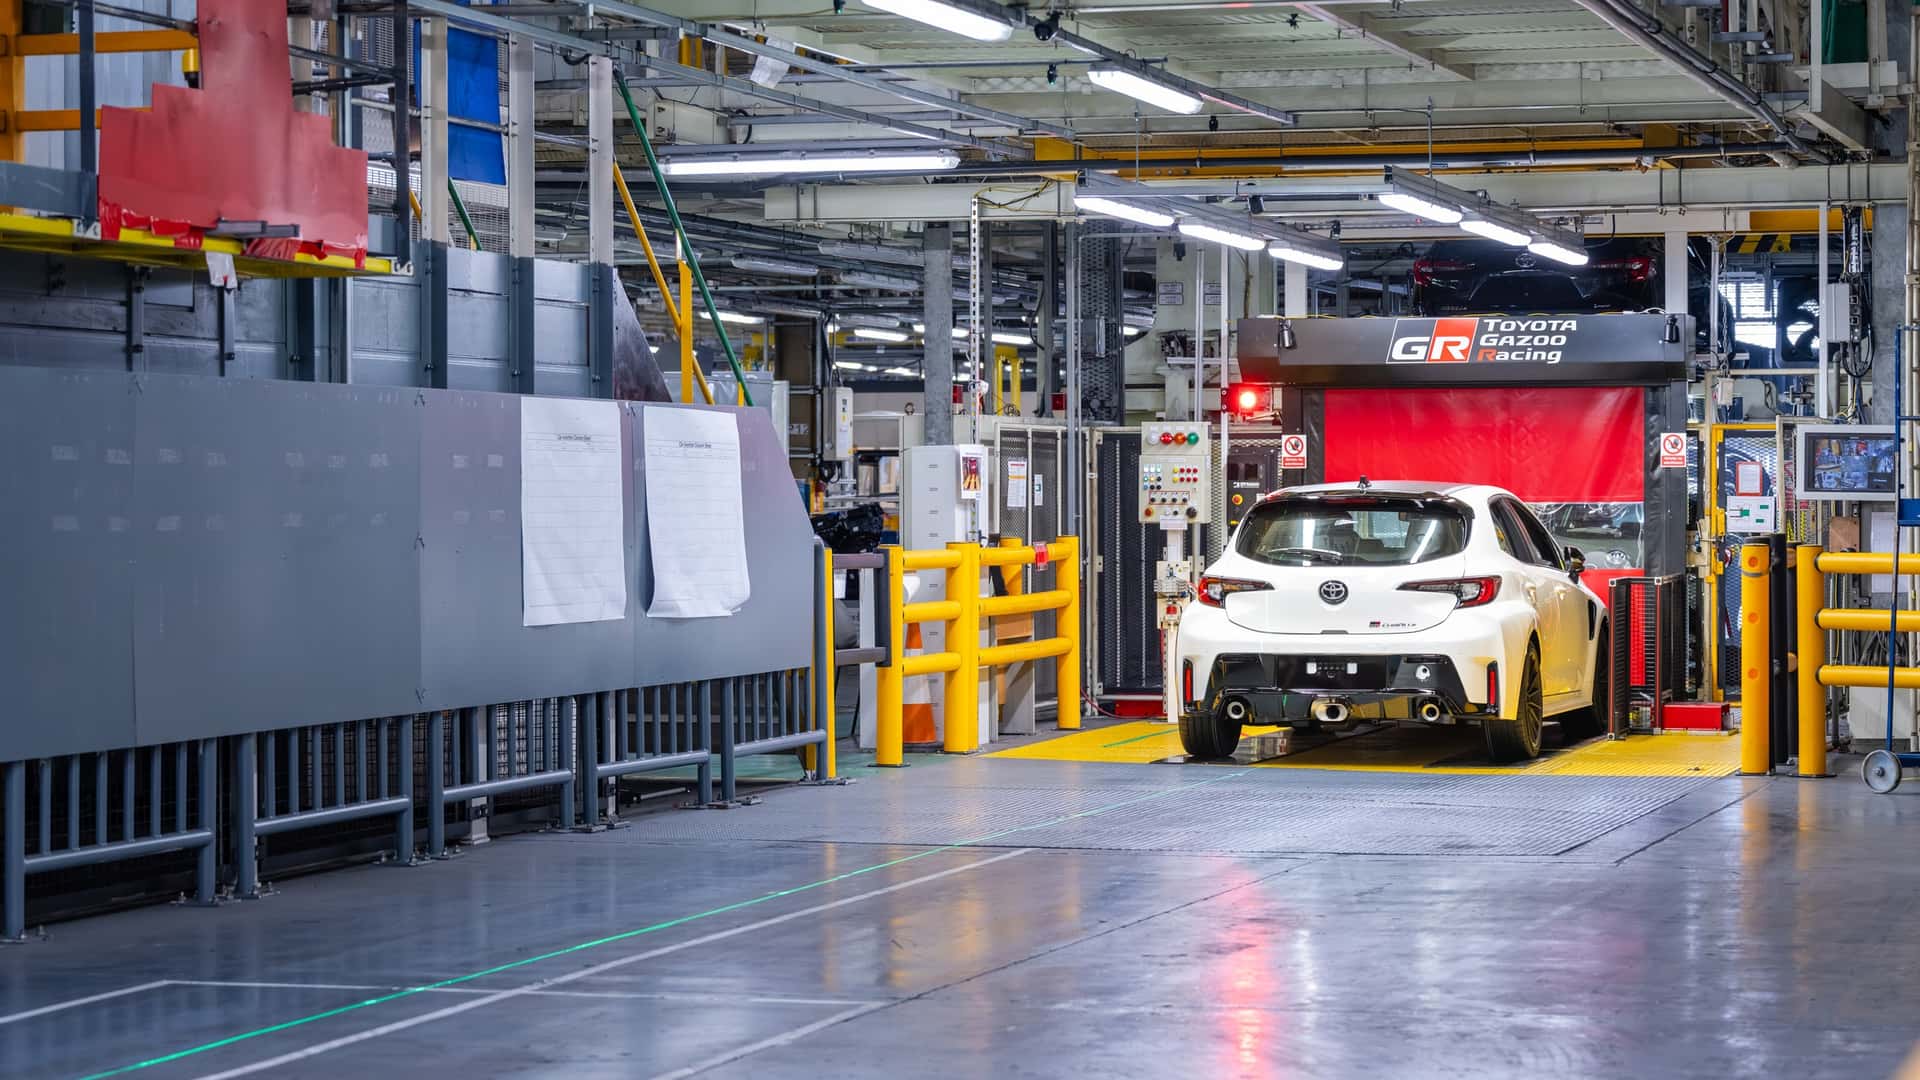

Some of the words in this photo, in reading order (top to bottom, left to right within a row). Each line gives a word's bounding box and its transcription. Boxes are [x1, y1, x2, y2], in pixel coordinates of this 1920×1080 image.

[1484, 319, 1577, 332] TOYOTA
[1479, 334, 1566, 346] GAZOO
[1391, 336, 1470, 360] GR
[1477, 348, 1562, 364] Racing
